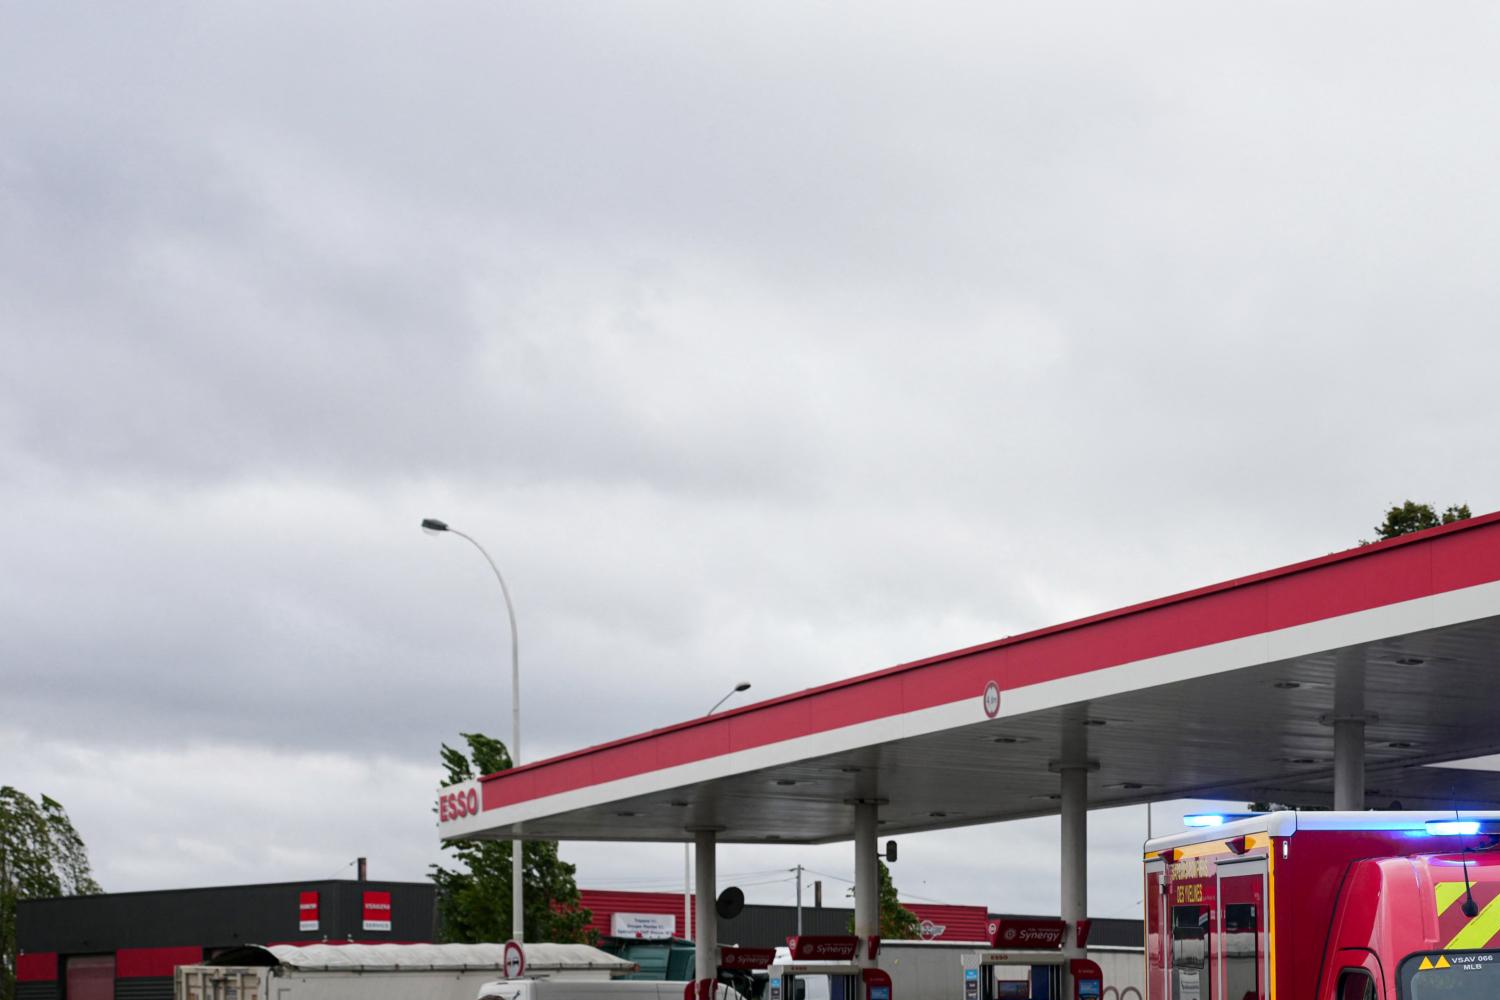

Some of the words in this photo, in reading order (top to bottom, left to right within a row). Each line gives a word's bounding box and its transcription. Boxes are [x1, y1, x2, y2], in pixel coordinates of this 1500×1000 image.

[440, 788, 478, 822] ESSO
[1018, 929, 1060, 941] Synergy
[816, 943, 853, 955] Synergy
[737, 955, 769, 965] Synergy
[1463, 963, 1482, 971] MLB
